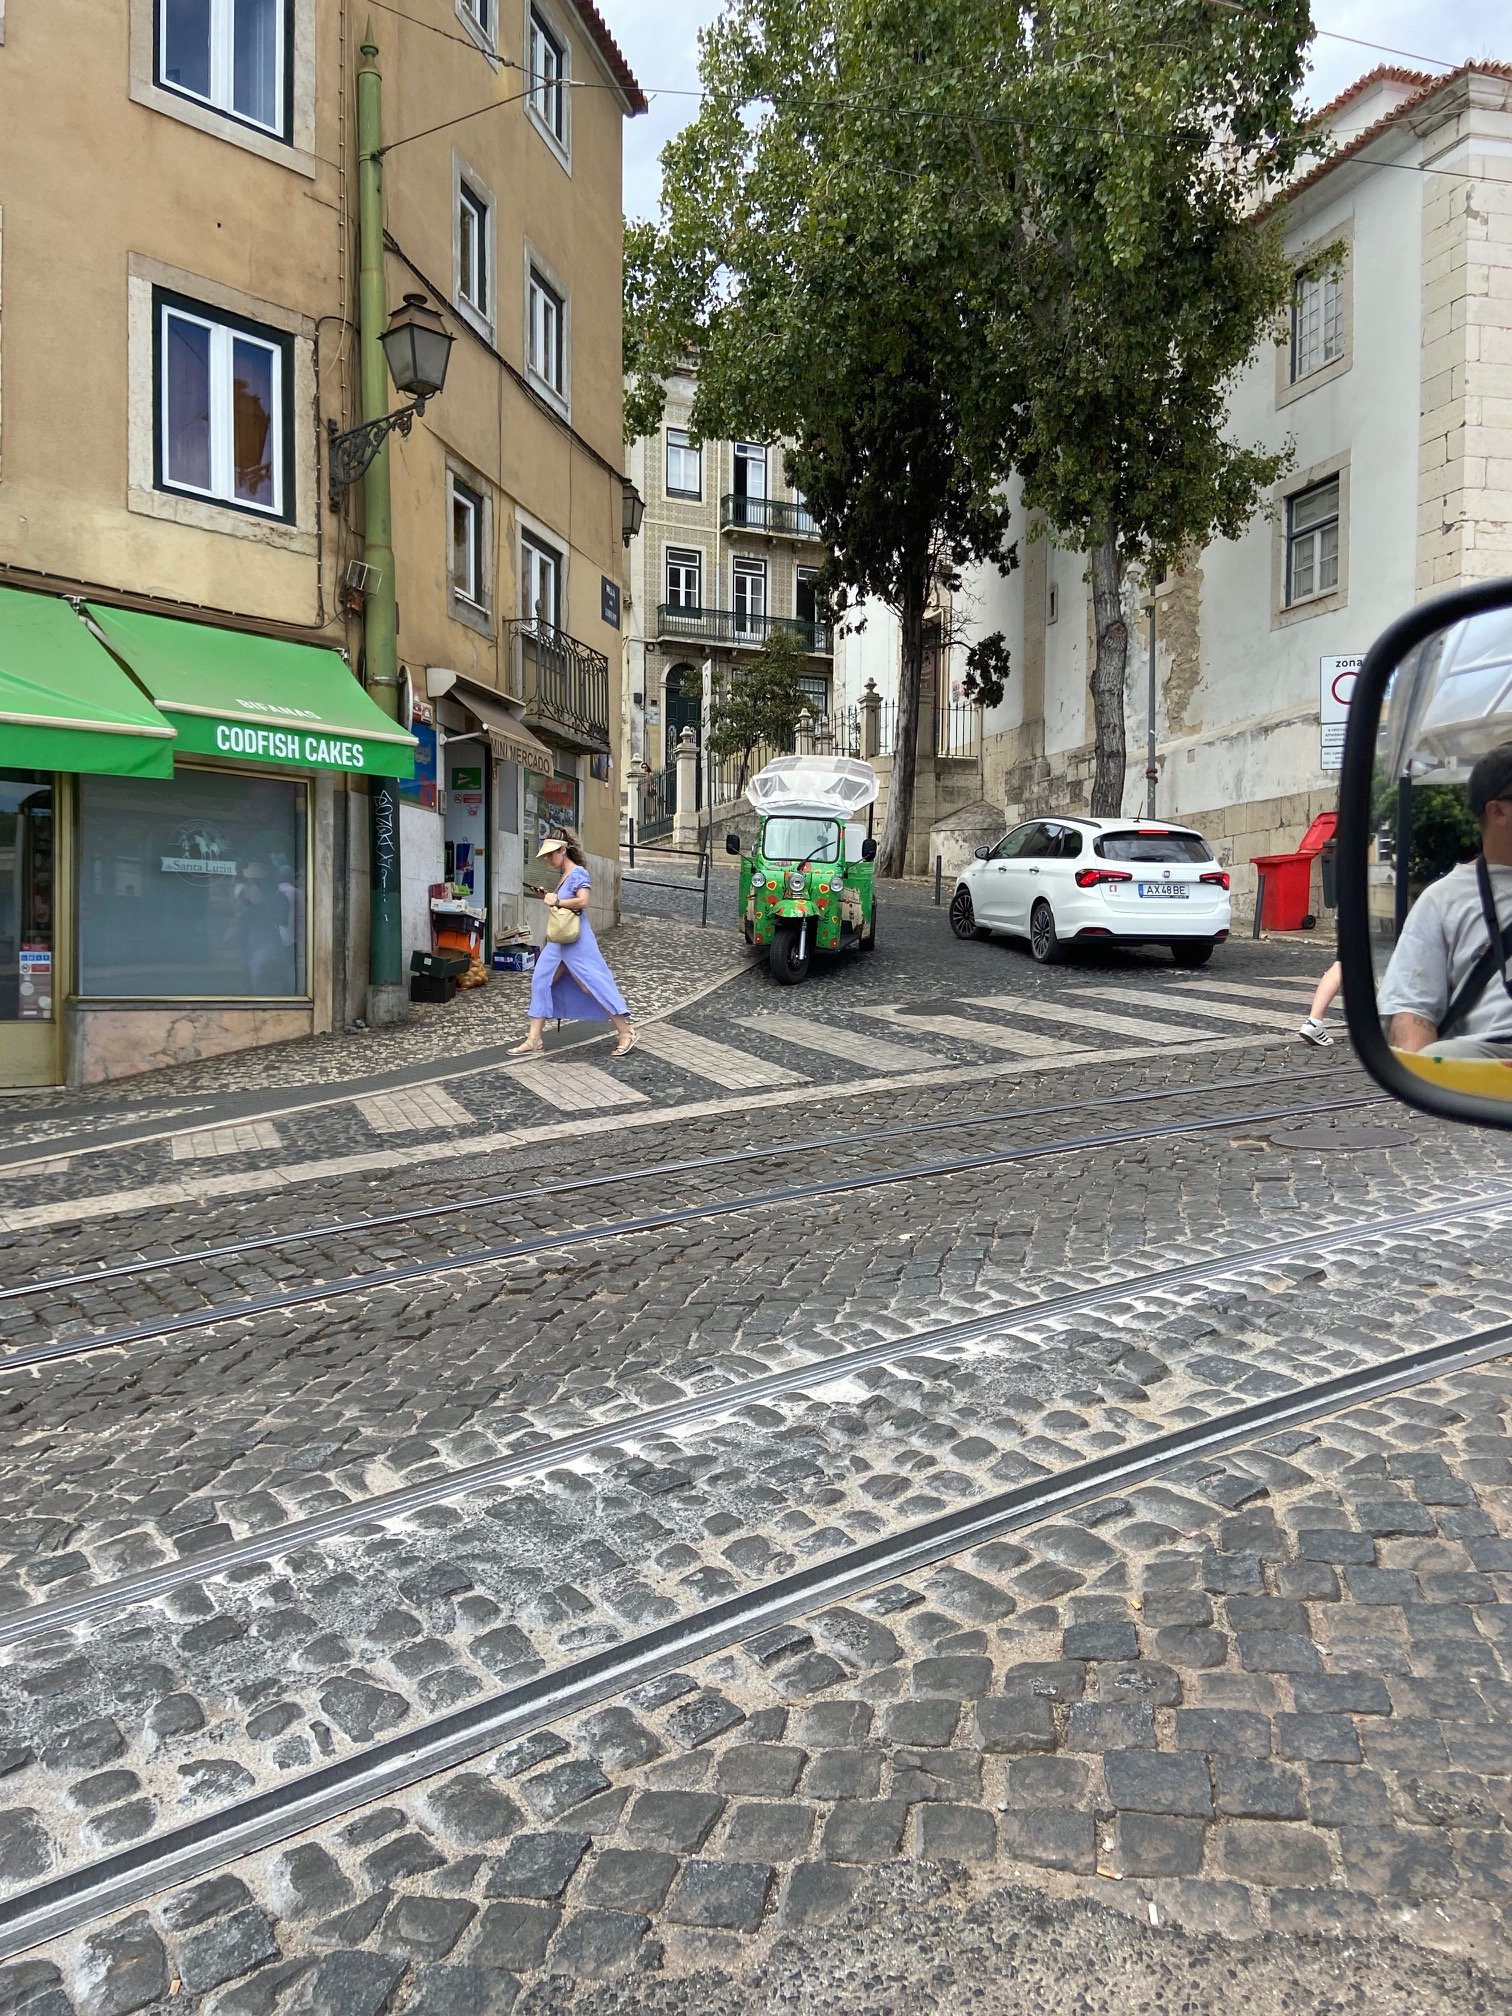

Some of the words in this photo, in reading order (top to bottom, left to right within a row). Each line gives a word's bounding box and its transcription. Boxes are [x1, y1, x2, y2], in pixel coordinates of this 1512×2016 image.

[1336, 659, 1363, 668] zona
[217, 725, 300, 759] CODFISH
[305, 737, 364, 768] CAKES
[491, 737, 508, 759] MINI
[510, 745, 550, 773] MERCADO
[173, 861, 203, 872] Santa
[205, 862, 232, 873] Luzia
